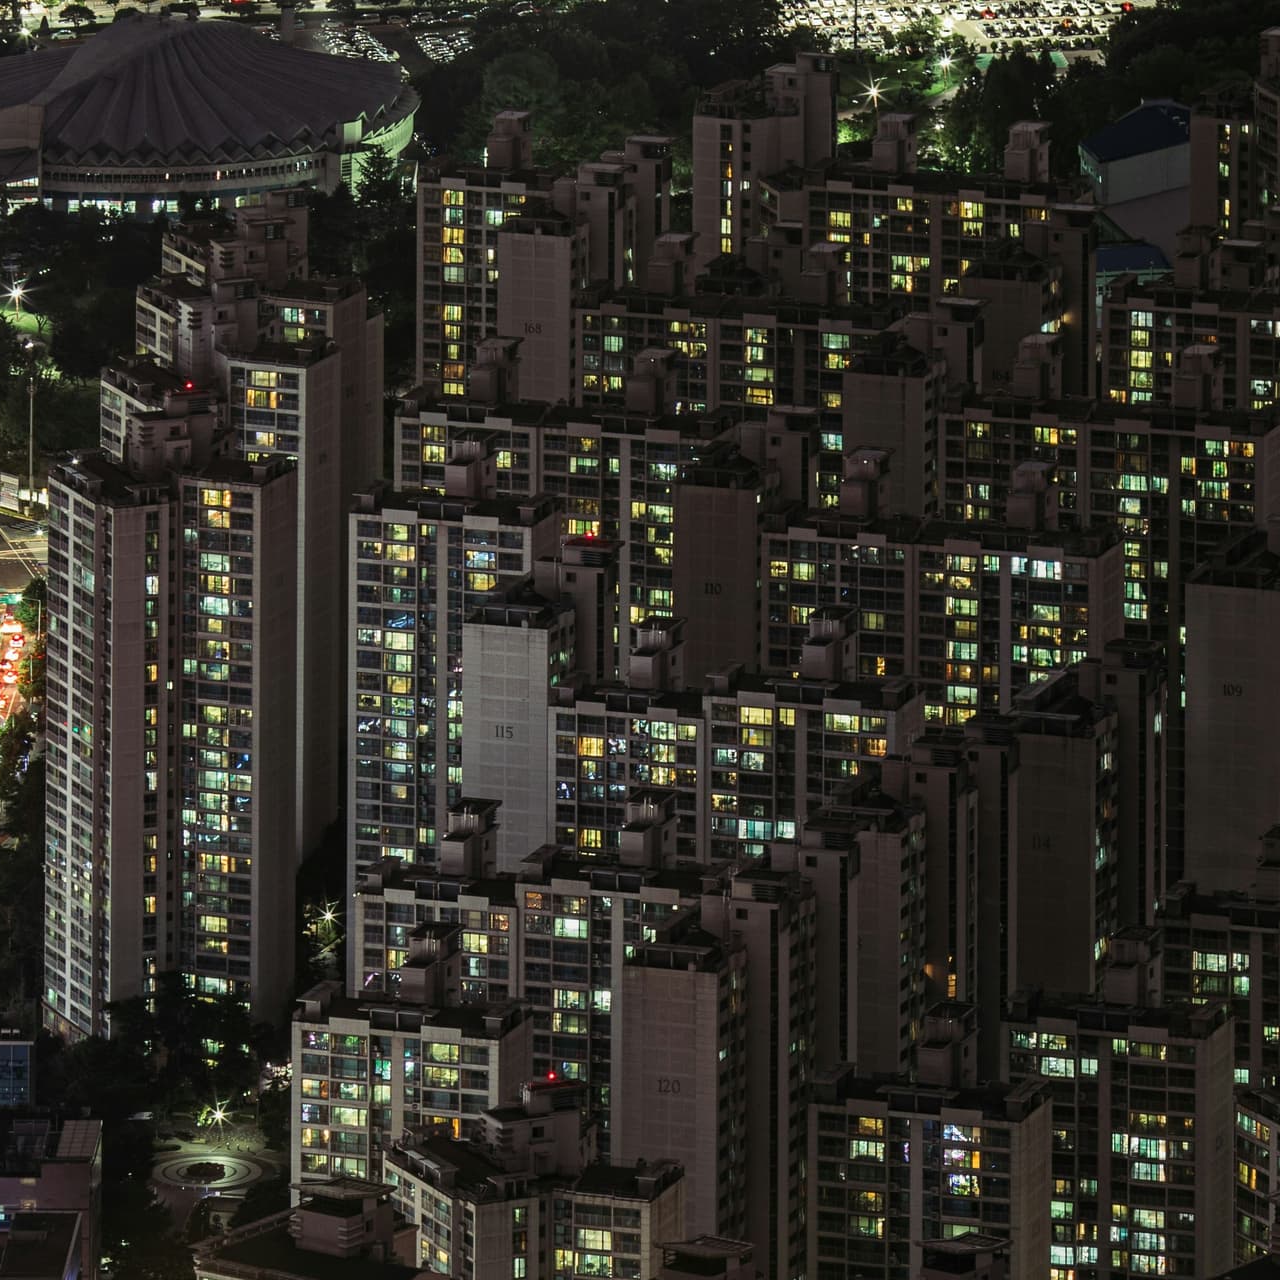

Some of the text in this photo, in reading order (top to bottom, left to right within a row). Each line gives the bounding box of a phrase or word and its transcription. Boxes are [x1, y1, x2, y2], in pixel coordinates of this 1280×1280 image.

[524, 322, 542, 334] 168
[704, 582, 722, 595] 110
[1223, 683, 1243, 696] 109
[495, 725, 514, 738] 115
[657, 1078, 681, 1094] 120
